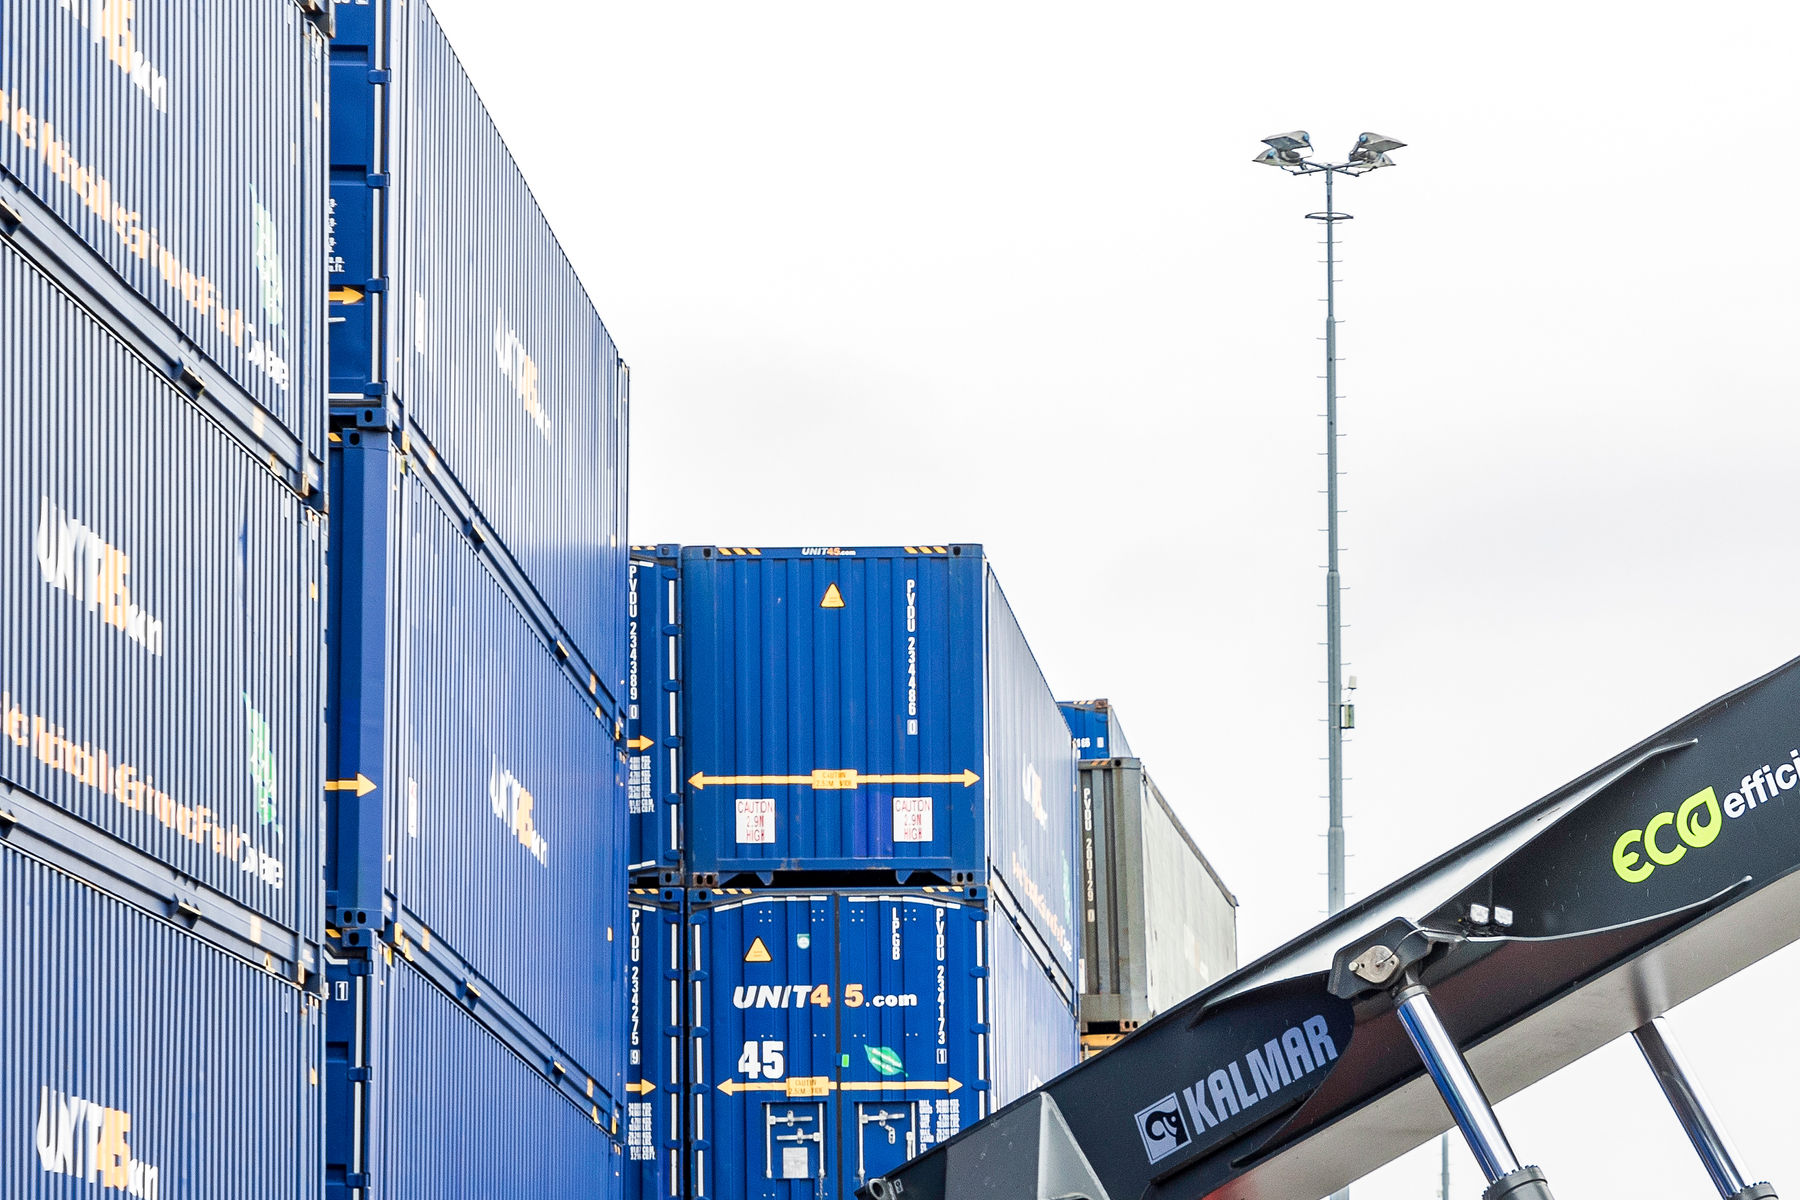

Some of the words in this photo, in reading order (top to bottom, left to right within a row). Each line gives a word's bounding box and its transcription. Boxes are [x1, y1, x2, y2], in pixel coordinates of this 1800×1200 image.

[629, 565, 637, 617] PVDU
[907, 580, 916, 632] PVDU
[629, 622, 638, 700] 234389
[908, 637, 916, 716] 234486
[1083, 788, 1091, 830] PVDU
[631, 909, 639, 961] PVDU
[892, 908, 900, 960] LPGB
[935, 908, 944, 961] PVDU
[631, 967, 639, 1045] 234275
[937, 966, 945, 1044] 234173
[738, 1041, 784, 1079] 45
[1183, 1013, 1339, 1135] KALMAR
